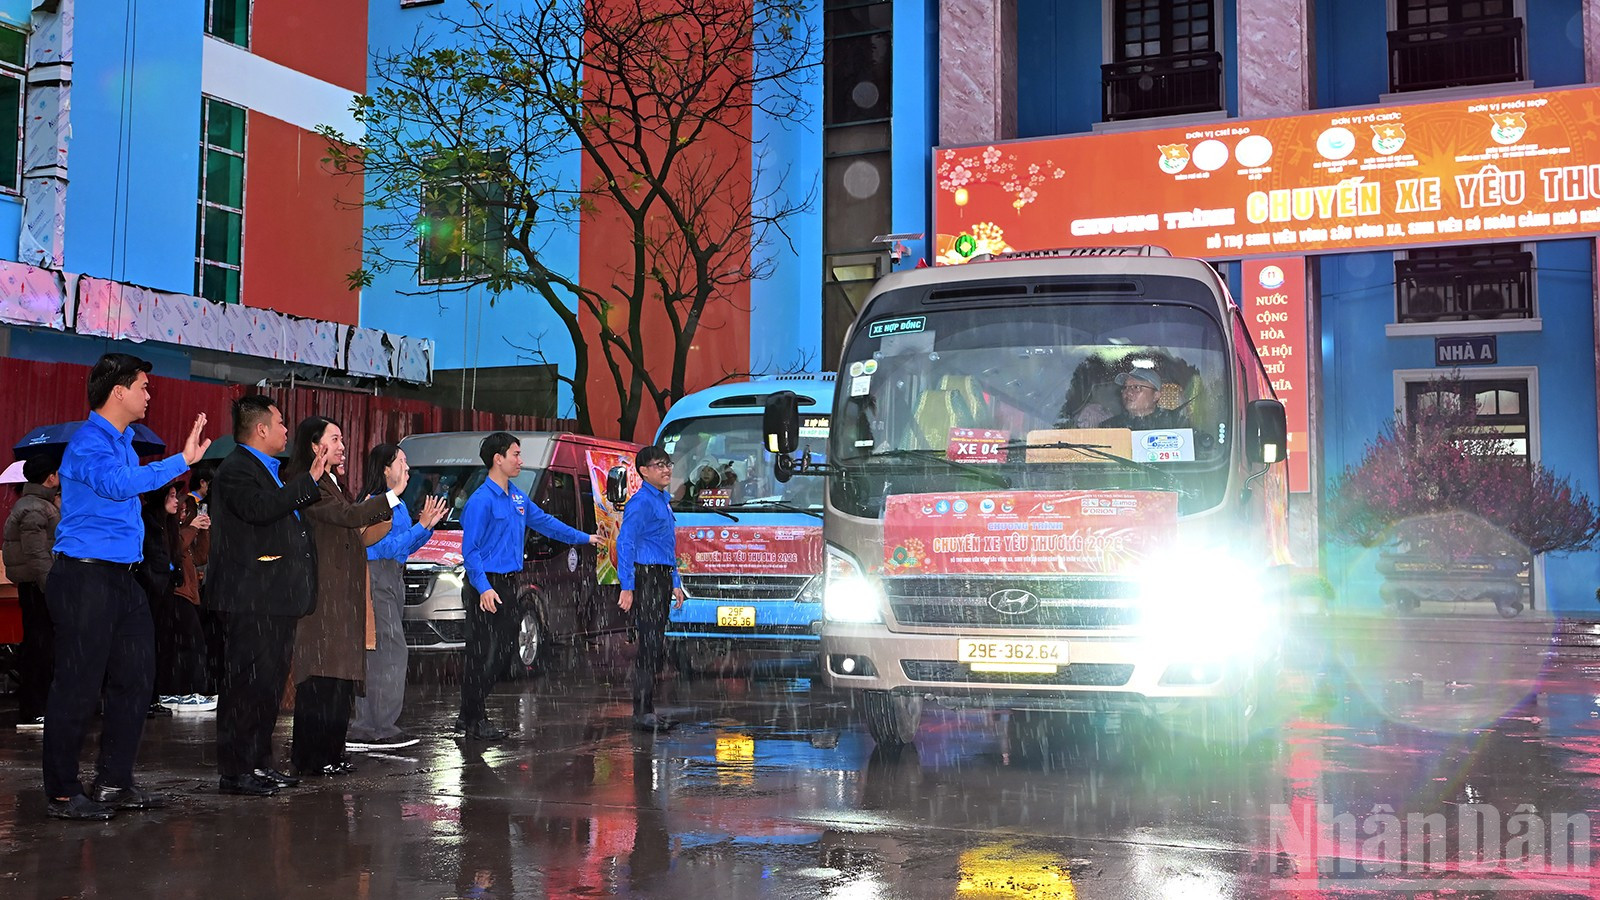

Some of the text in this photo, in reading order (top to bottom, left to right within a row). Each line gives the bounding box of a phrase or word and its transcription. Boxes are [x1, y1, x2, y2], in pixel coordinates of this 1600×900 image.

[1246, 176, 1381, 224] CHUYẾN
[1395, 176, 1441, 214] XE
[1454, 163, 1525, 209] YÊU
[1386, 222, 1406, 238] XA,
[1256, 294, 1288, 306] NƯỚC
[1256, 310, 1288, 326] CỘNG
[873, 325, 884, 334] XE
[884, 322, 900, 333] HỢP
[1260, 328, 1285, 340] HÒA
[1272, 344, 1292, 358] HỘI
[1440, 342, 1492, 360] NHÀ A
[957, 443, 999, 455] XE 04
[1159, 452, 1170, 460] 29
[716, 498, 726, 506] 02
[933, 533, 980, 553] CHUYẾN
[984, 536, 1000, 552] XE
[1004, 532, 1028, 552] YÊU
[728, 608, 744, 616] 29F
[722, 617, 750, 626] 025.36
[968, 644, 1059, 659] 29E-362.64
